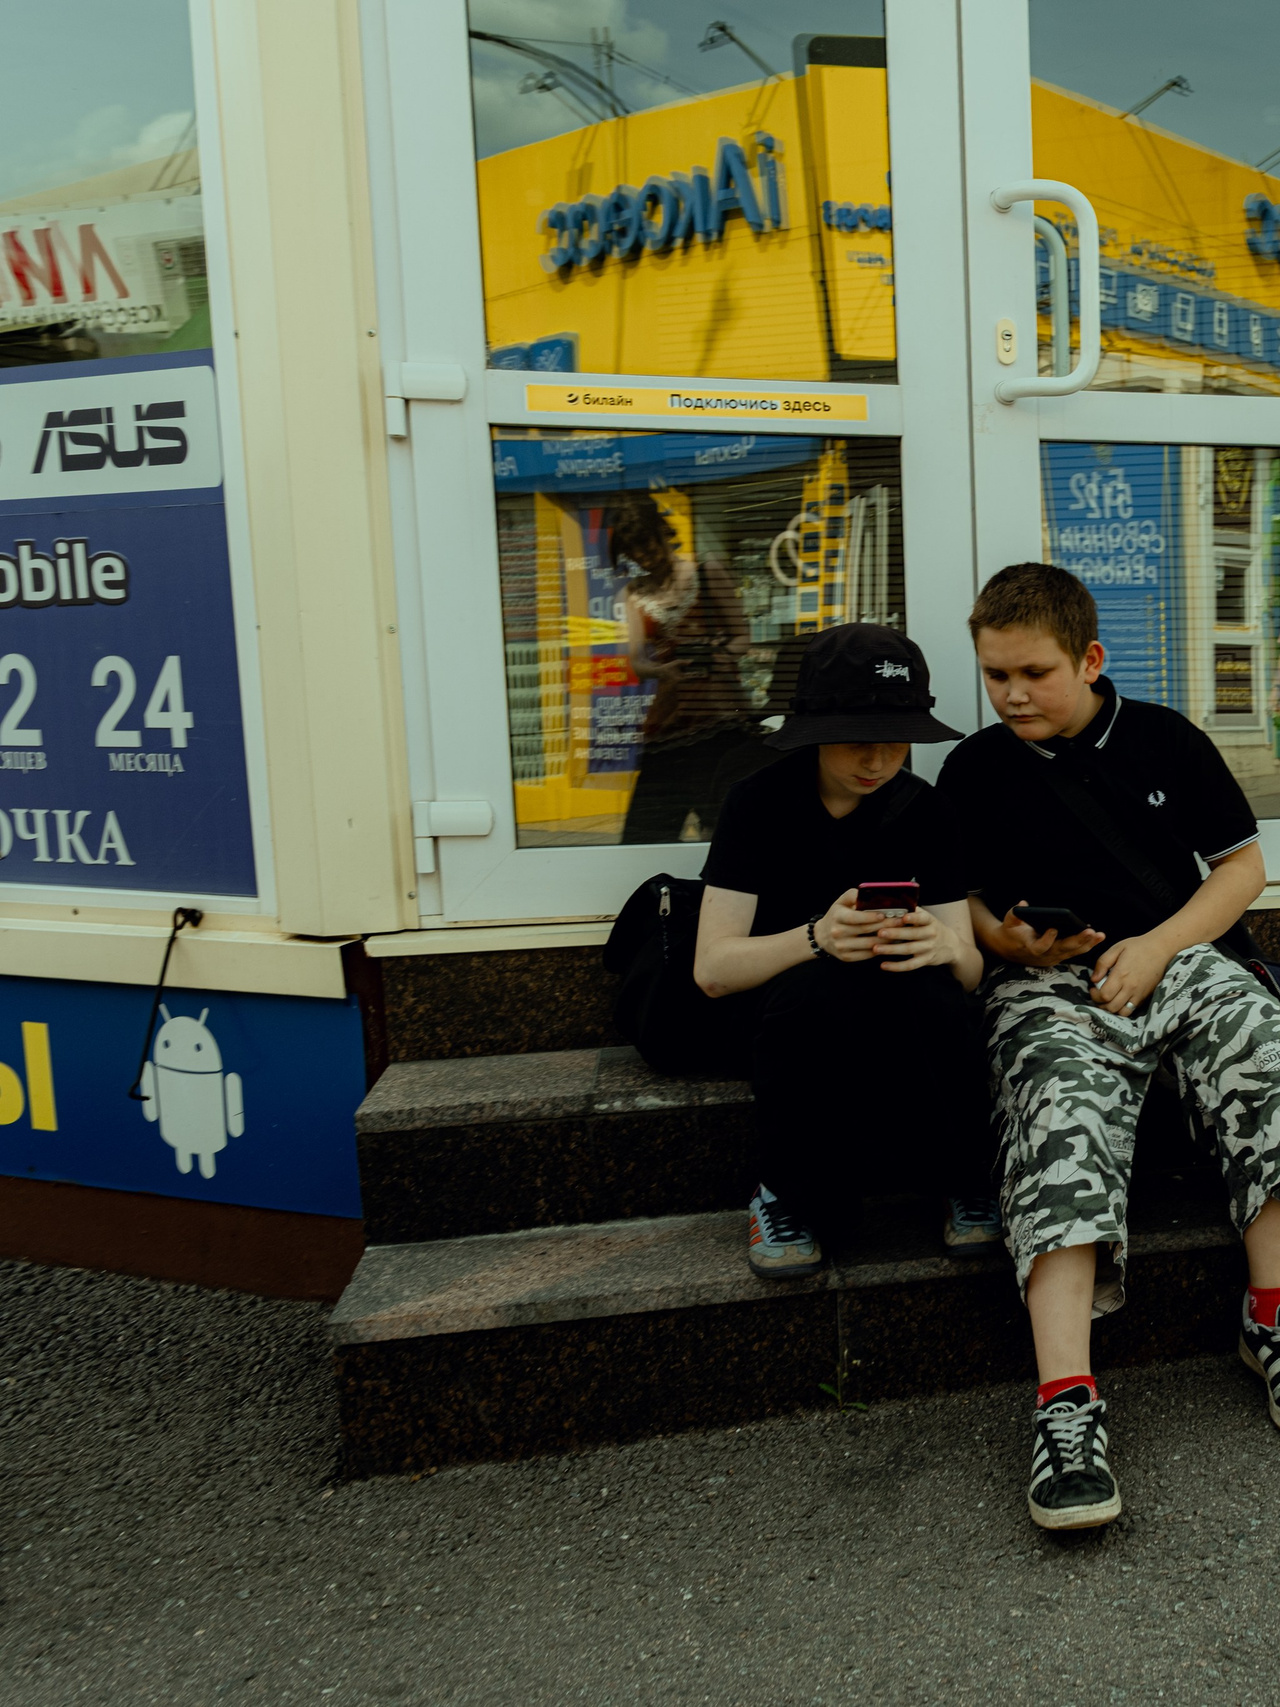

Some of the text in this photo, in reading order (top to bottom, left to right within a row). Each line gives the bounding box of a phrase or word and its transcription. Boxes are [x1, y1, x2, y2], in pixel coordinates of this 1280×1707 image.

[582, 391, 832, 413] билайн Подключись здесь
[32, 400, 188, 475] ASUS
[91, 655, 194, 748] 24
[0, 751, 185, 777] ЯЦЕВ МЕСЯЦА
